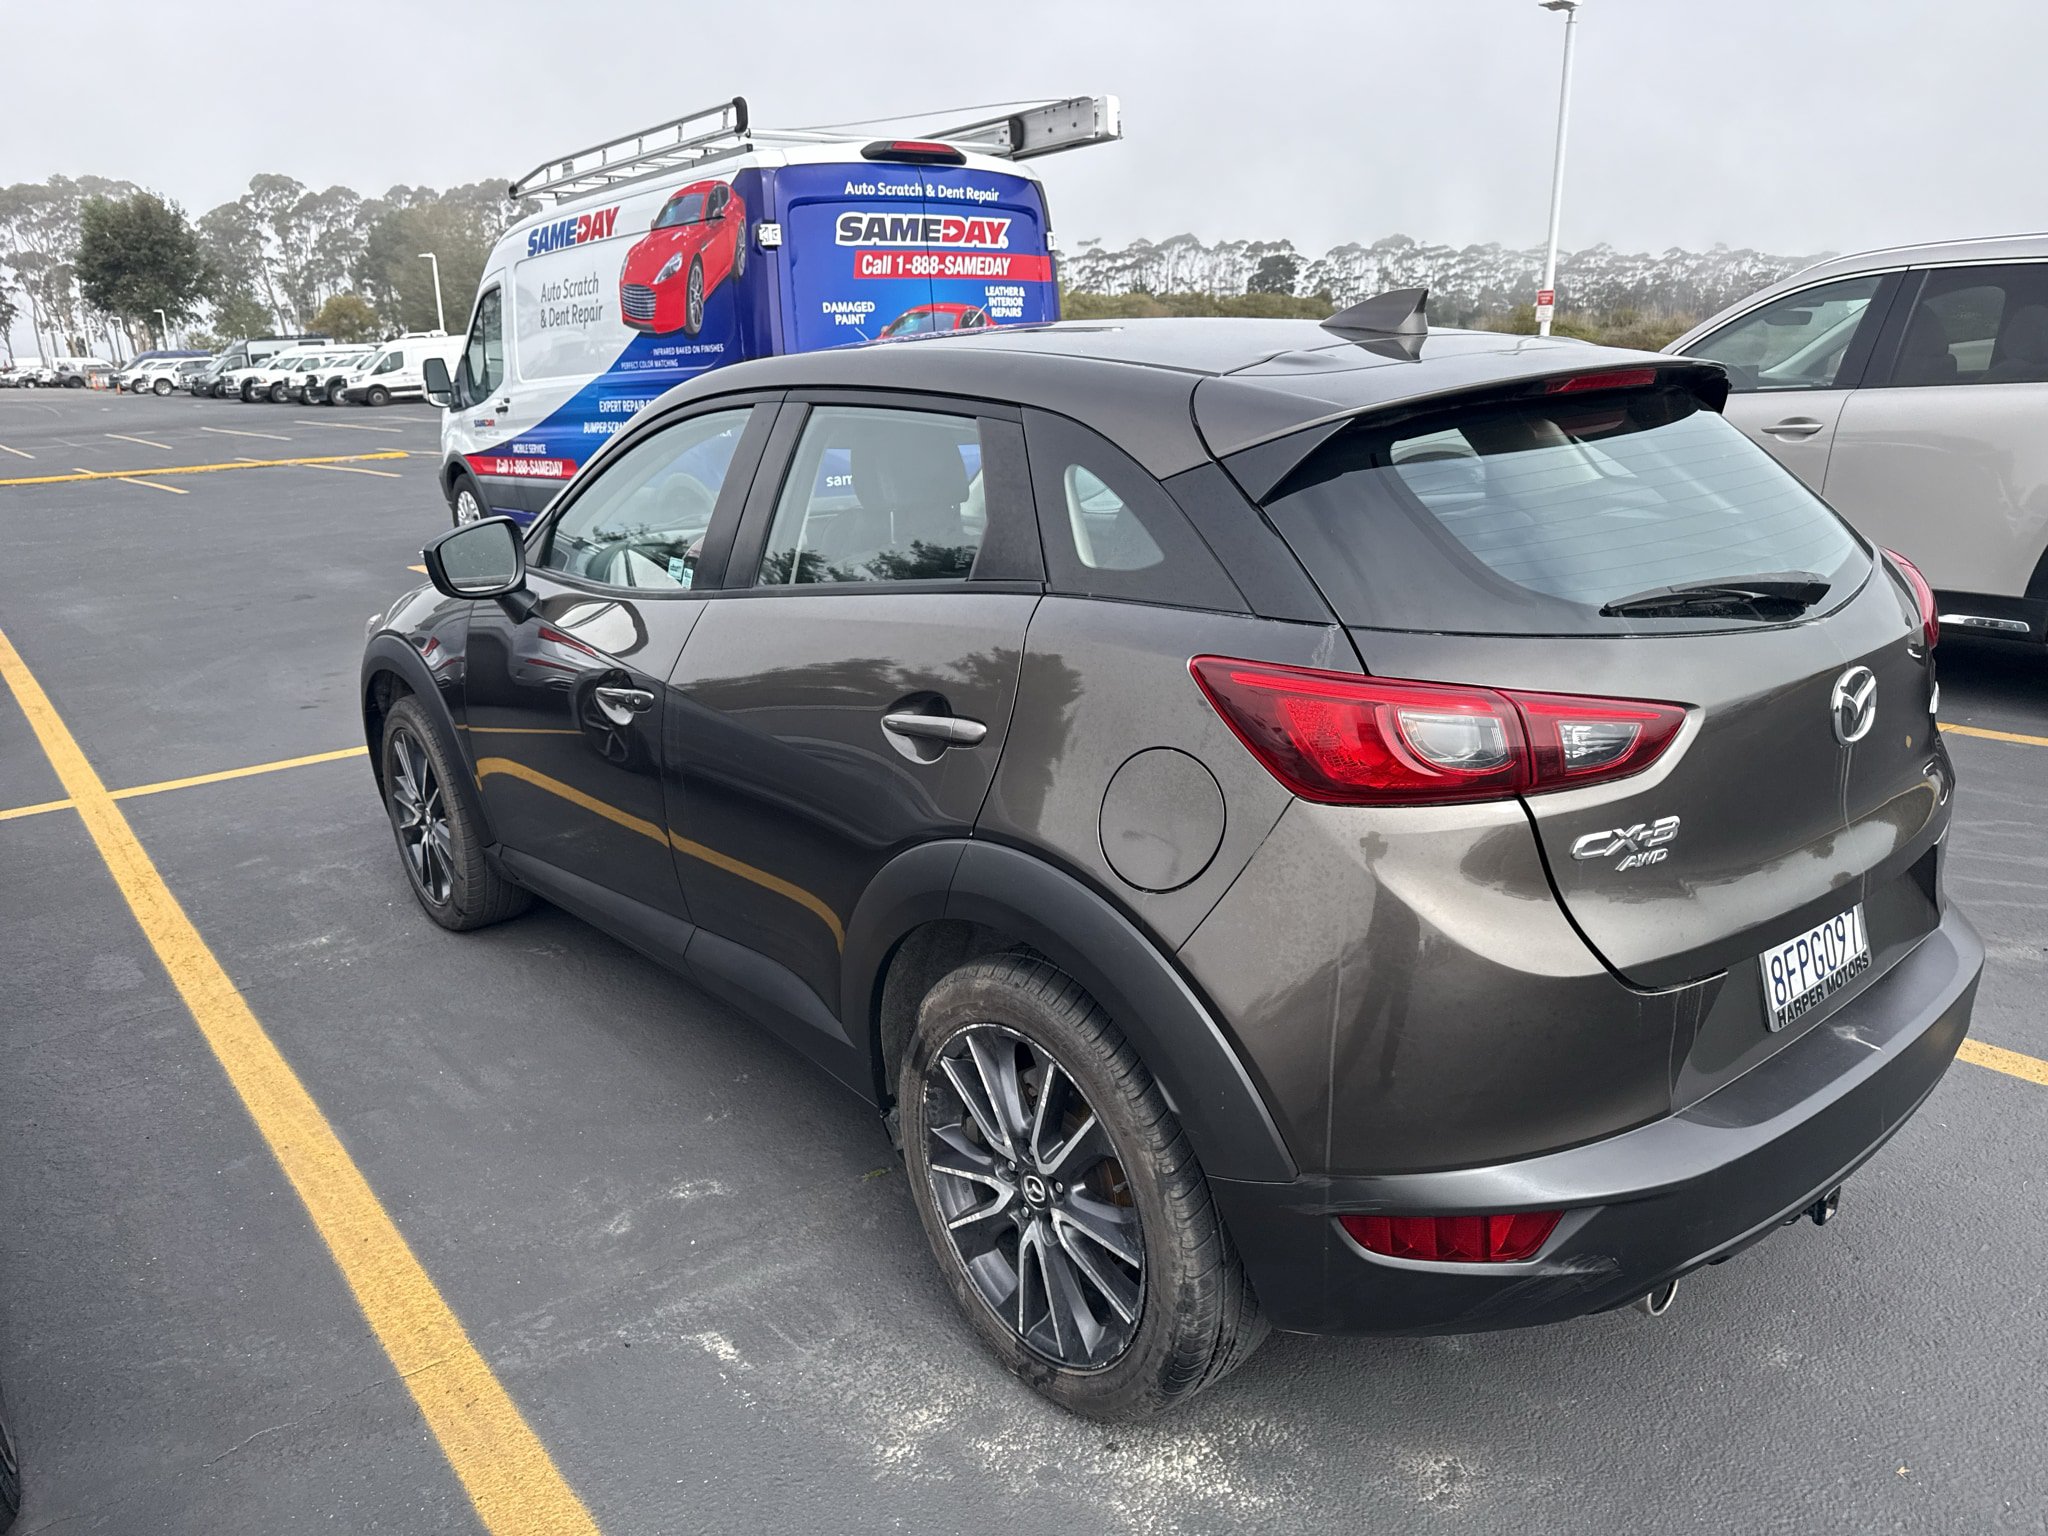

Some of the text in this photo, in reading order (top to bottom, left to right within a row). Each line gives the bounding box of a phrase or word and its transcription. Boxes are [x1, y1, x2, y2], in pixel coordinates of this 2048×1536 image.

[845, 182, 999, 204] Auto Scratch & Dent Repair
[527, 205, 620, 257] SAMEDAY
[838, 214, 1009, 246] SAMEDAY
[862, 254, 1011, 276] Call 1-888-SAMEDAY
[541, 271, 599, 303] Auto Scratch
[985, 285, 1026, 297] LEATHER &
[822, 301, 876, 313] DAMAGED
[988, 296, 1024, 307] INTERIOR
[991, 307, 1022, 318] REPAIRS
[540, 298, 603, 329] & Dent Repair
[835, 313, 866, 325] PAINT
[692, 345, 701, 354] ON
[701, 343, 725, 353] FINISHES
[599, 400, 621, 413] EXPERT
[583, 421, 607, 434] BUMPER
[1570, 815, 1681, 860] CX-3
[1615, 848, 1669, 872] AWD
[1770, 907, 1859, 1006] 8FPG097
[1776, 951, 1869, 1029] HARPER MOTORS
